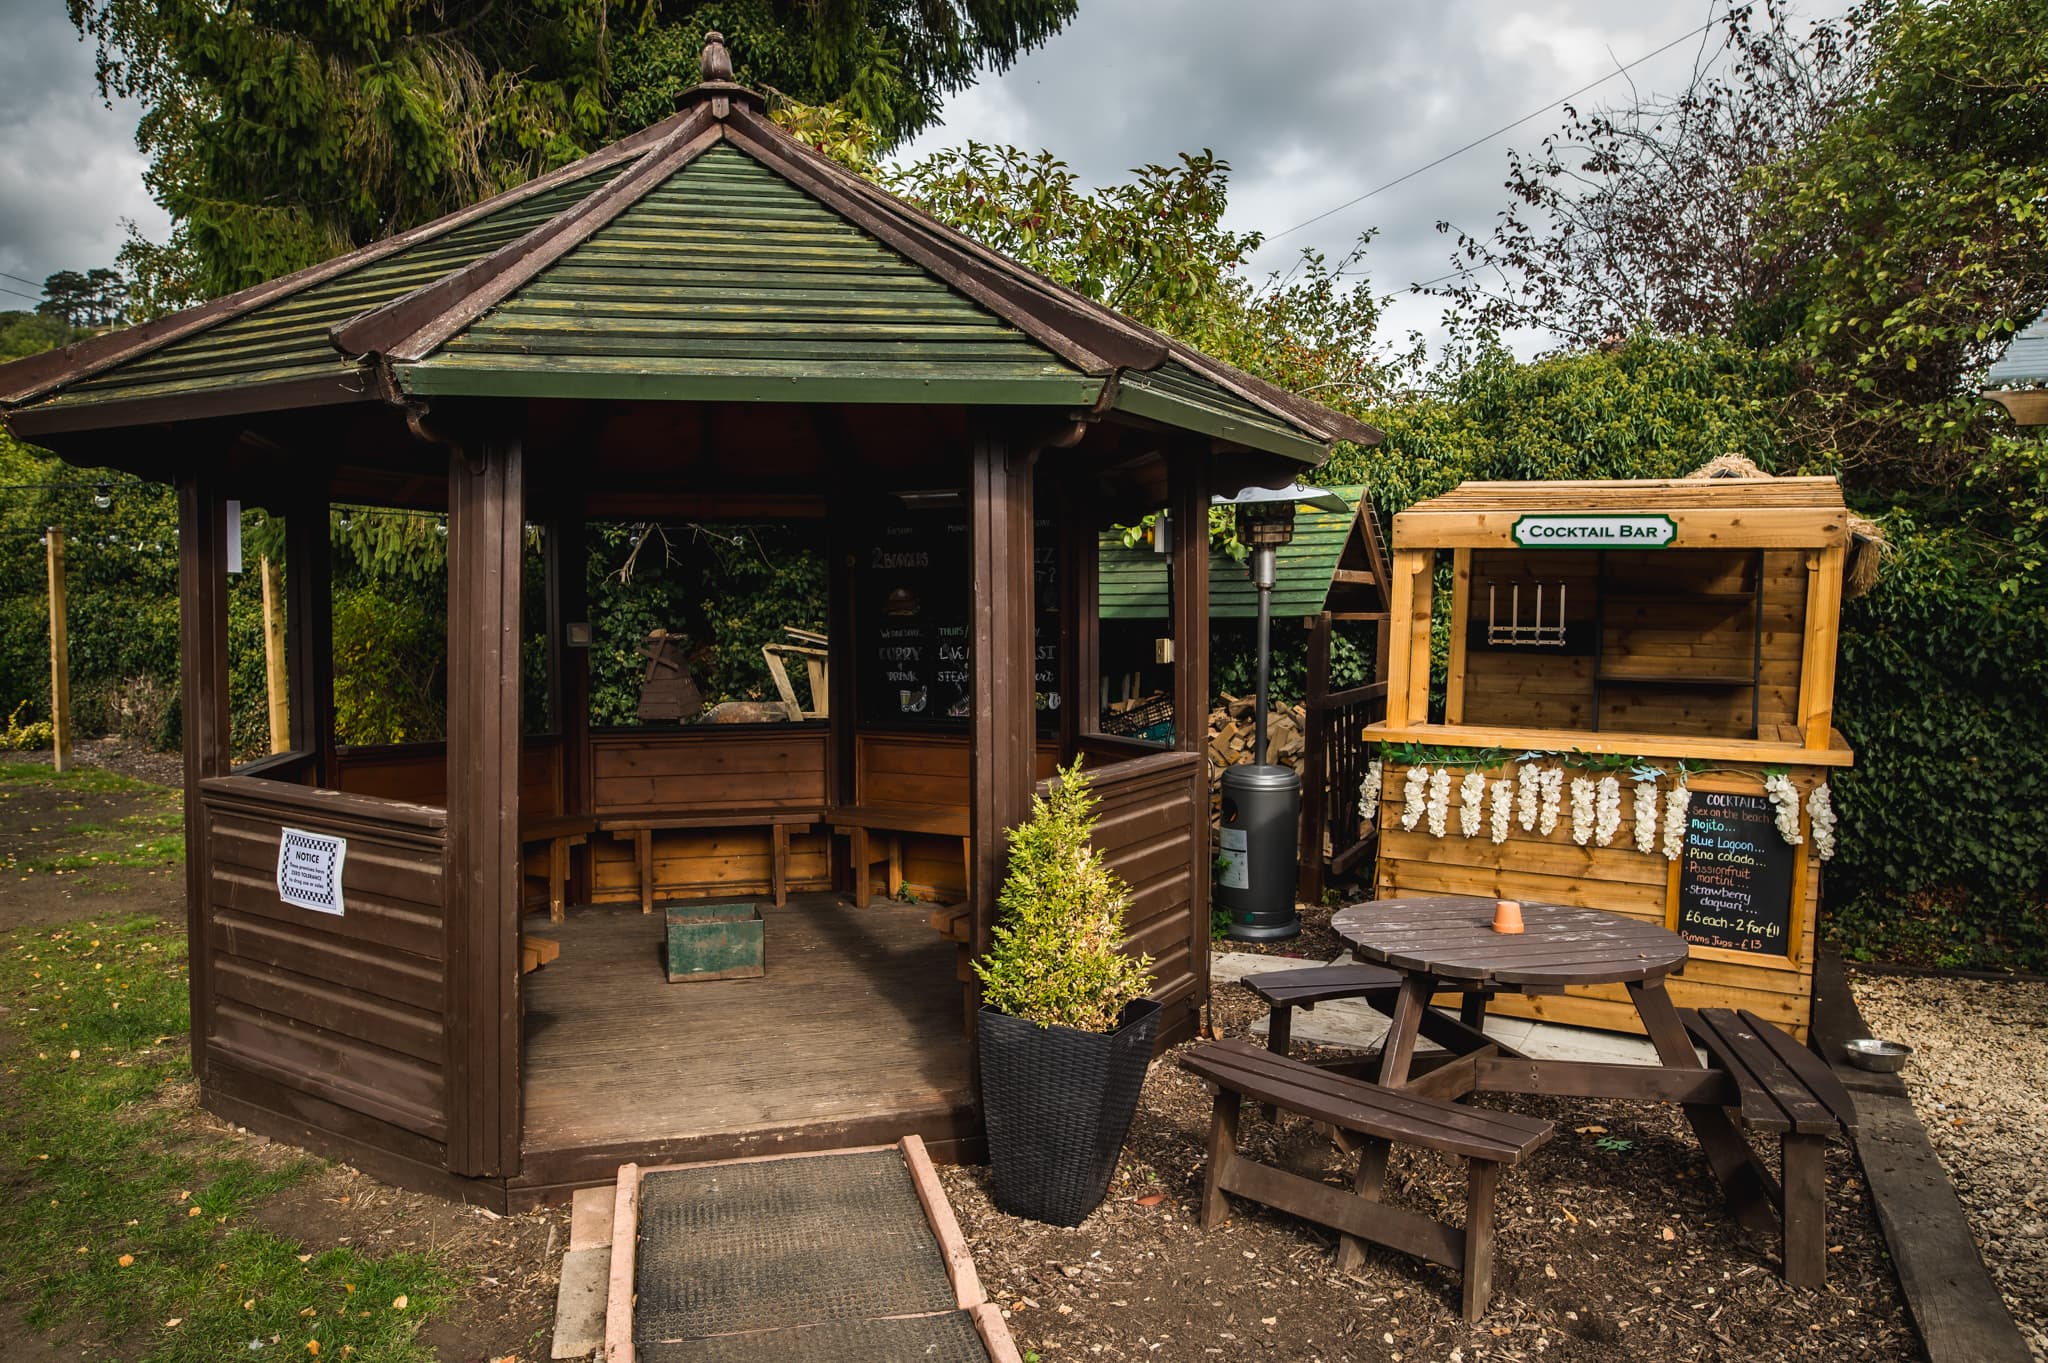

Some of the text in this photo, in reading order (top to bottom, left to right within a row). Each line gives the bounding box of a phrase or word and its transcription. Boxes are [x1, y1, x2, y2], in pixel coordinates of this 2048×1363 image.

[1529, 525, 1658, 538] COCKTAIL BAR
[1692, 806, 1708, 816] Sex
[1710, 809, 1721, 817] on
[1723, 808, 1738, 819] the
[296, 851, 319, 863] NOTICE
[1690, 848, 1714, 860] Pina
[1690, 860, 1751, 879] Passionfruit
[1686, 910, 1701, 923] £6
[1703, 917, 1728, 929] each
[1736, 919, 1745, 931] 2
[1746, 920, 1765, 934] for
[1766, 922, 1780, 938] £11
[1681, 930, 1710, 944] Pimms
